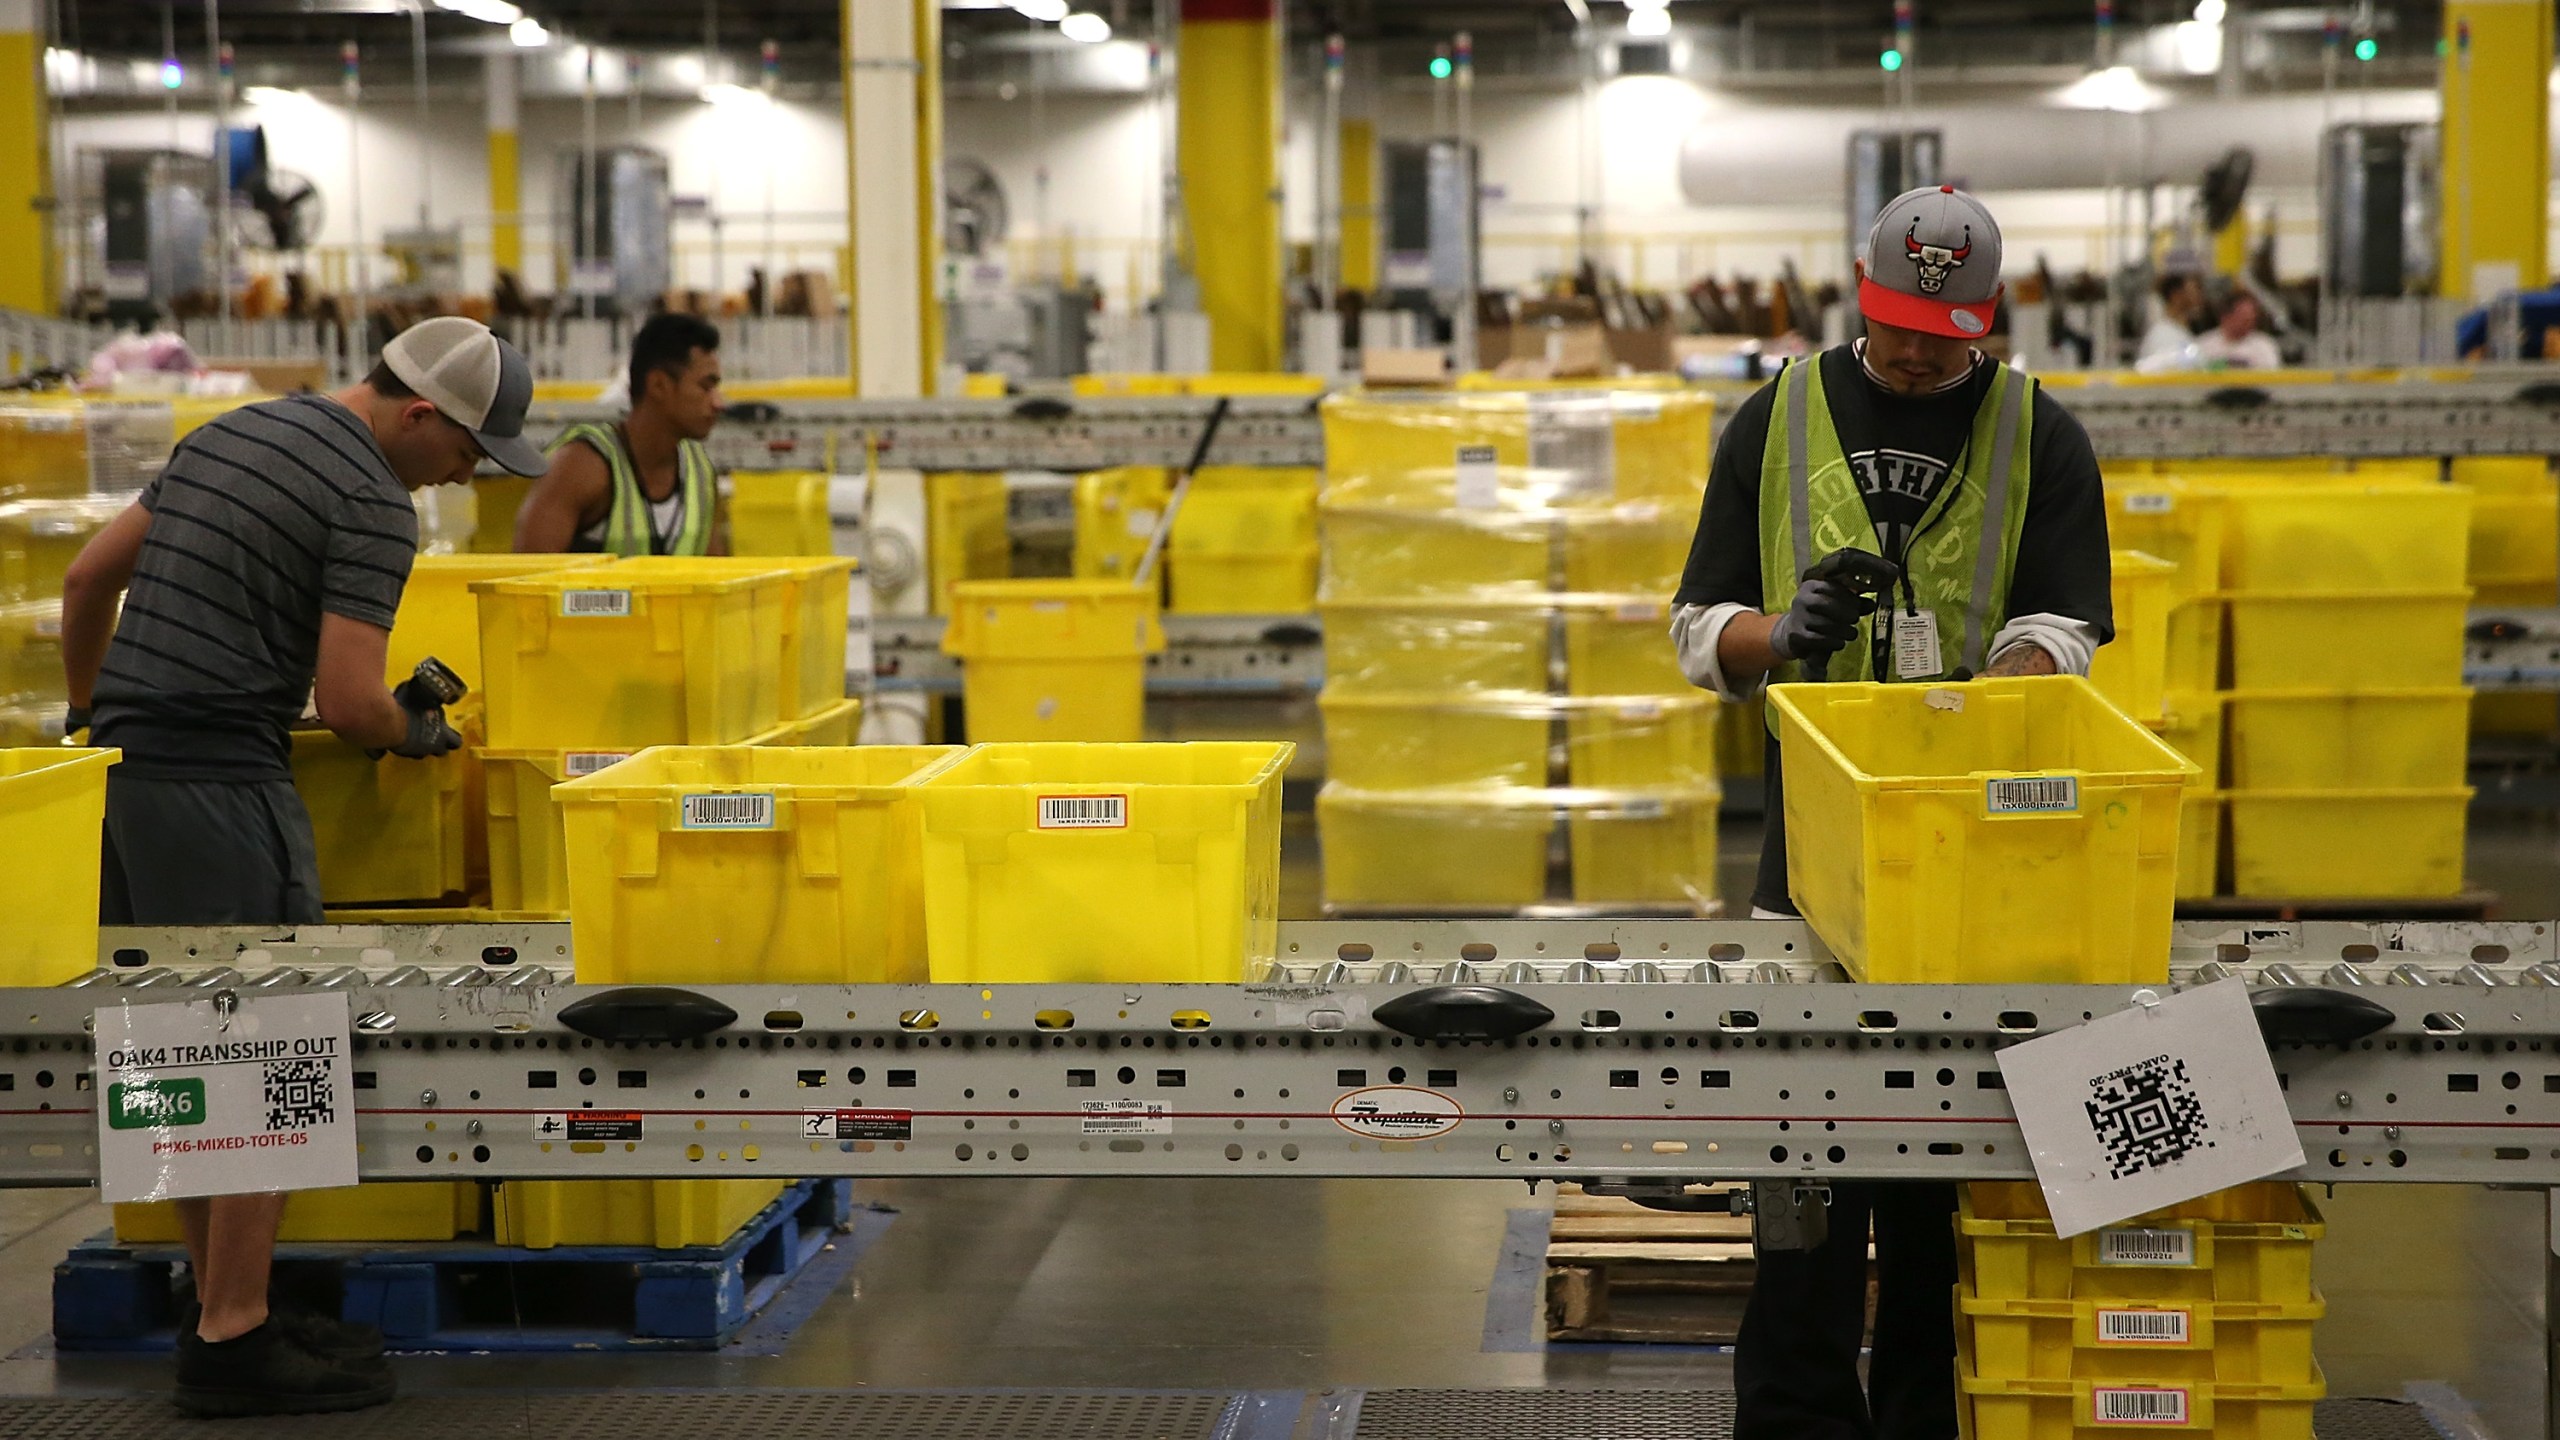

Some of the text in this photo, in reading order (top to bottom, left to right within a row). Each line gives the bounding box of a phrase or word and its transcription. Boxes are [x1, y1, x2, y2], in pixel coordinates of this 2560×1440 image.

[108, 1037, 337, 1068] OAK4 TRANSSHIP OUT
[2089, 1054, 2170, 1087] OAK4-PRT-20
[152, 1132, 308, 1154] PHX6-MIXED-TOTE-05
